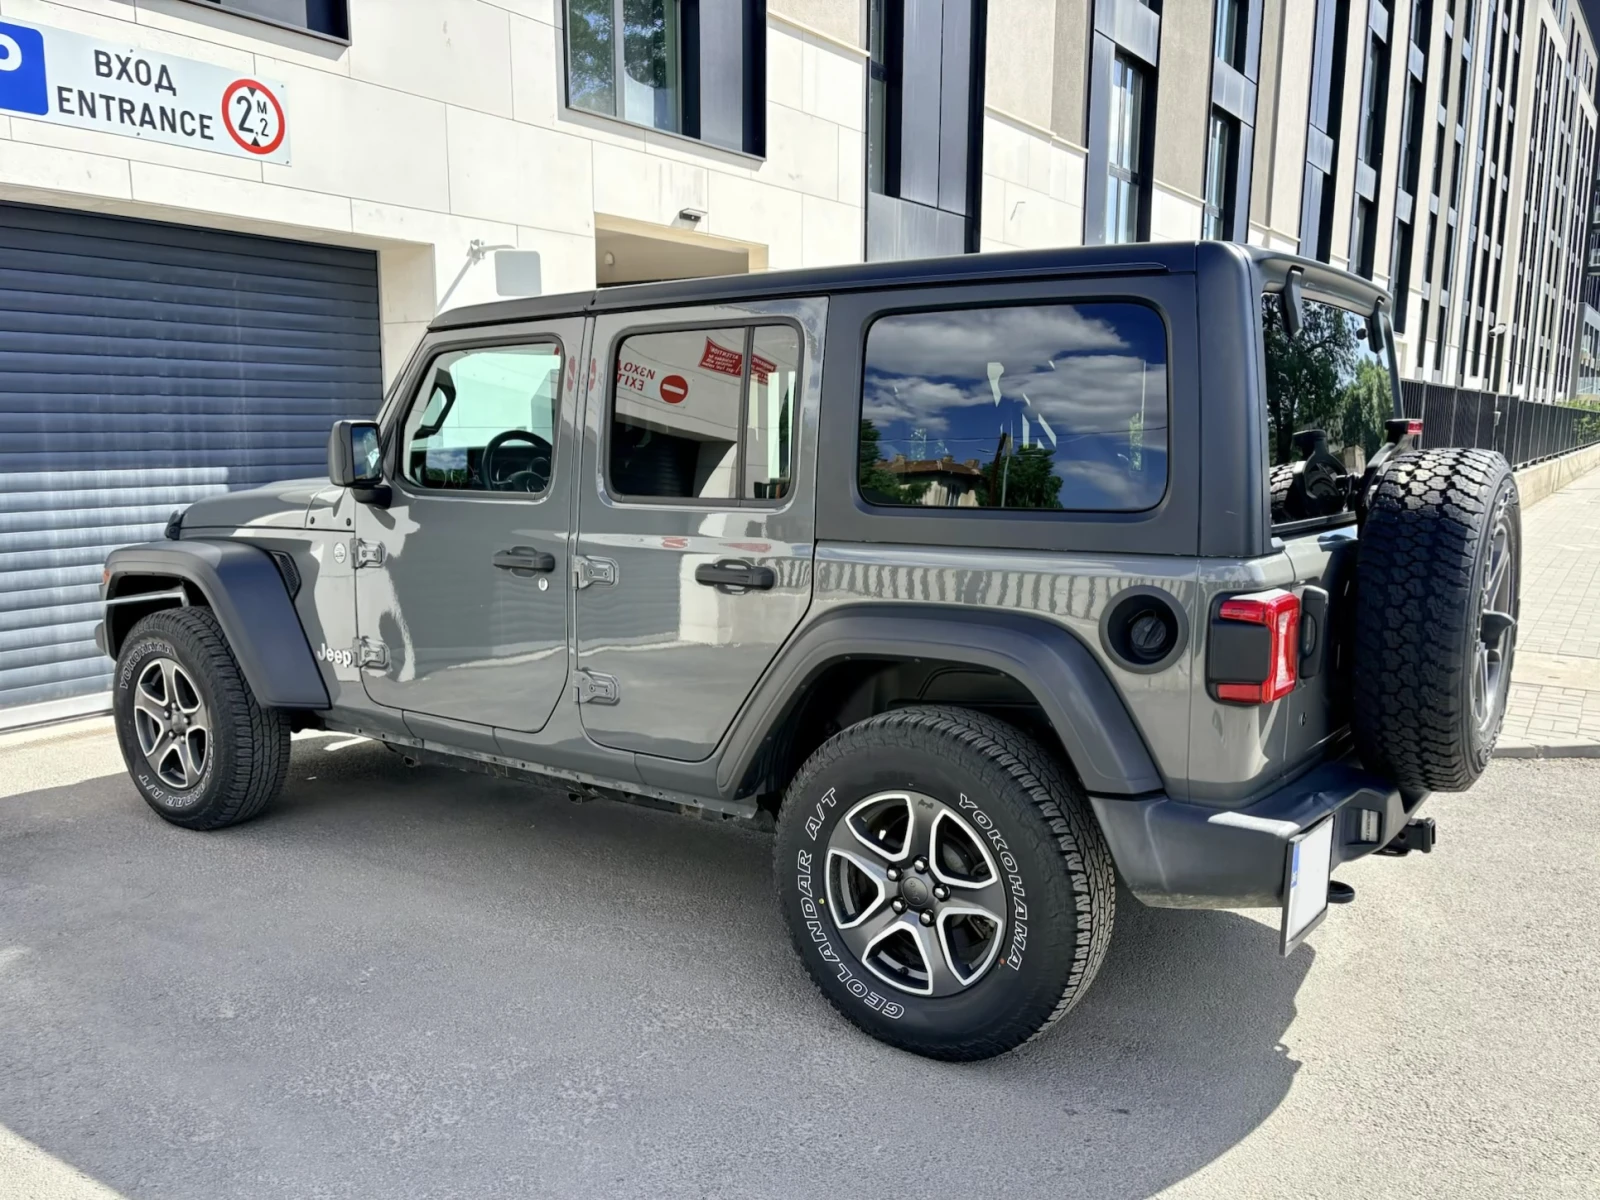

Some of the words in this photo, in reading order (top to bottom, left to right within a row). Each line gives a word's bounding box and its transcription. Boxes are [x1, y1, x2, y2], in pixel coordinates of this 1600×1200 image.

[94, 49, 177, 96] ВХОД
[57, 86, 215, 141] ENTRANCE
[317, 643, 352, 668] Jeep
[805, 787, 837, 841] A/T
[958, 792, 1028, 970] YOKOHAMA
[797, 849, 904, 1020] GEOLANDAR
